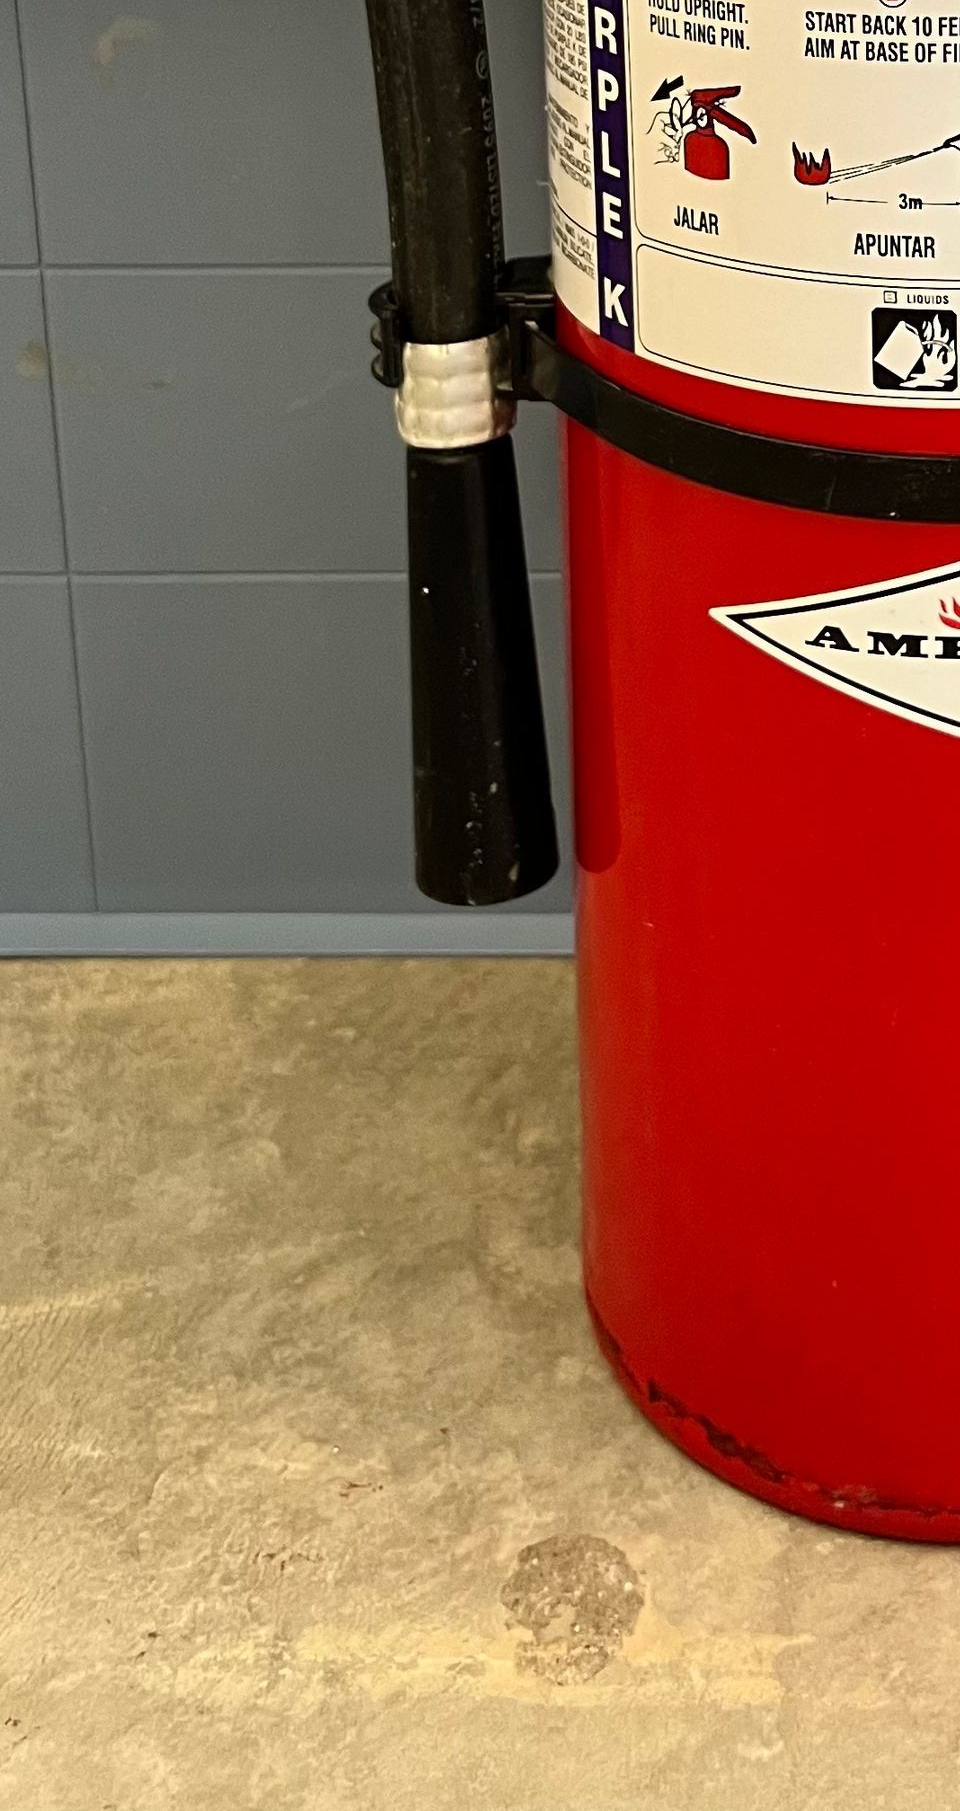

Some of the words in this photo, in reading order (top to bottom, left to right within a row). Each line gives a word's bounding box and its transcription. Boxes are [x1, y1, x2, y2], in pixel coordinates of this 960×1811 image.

[649, 14, 681, 38] PULL
[682, 22, 717, 44] RING
[717, 27, 750, 51] PIN.
[805, 12, 859, 34] START
[862, 15, 908, 36] BACK
[910, 15, 935, 36] 10
[804, 38, 837, 60] AIM
[840, 39, 862, 61] AT
[865, 41, 910, 63] BASE
[914, 42, 938, 64] OF
[898, 193, 923, 211] 3m
[673, 204, 720, 236] JALAR
[854, 232, 936, 259] APUNTAR
[602, 283, 630, 328] K
[906, 292, 950, 307] LIQUIDS
